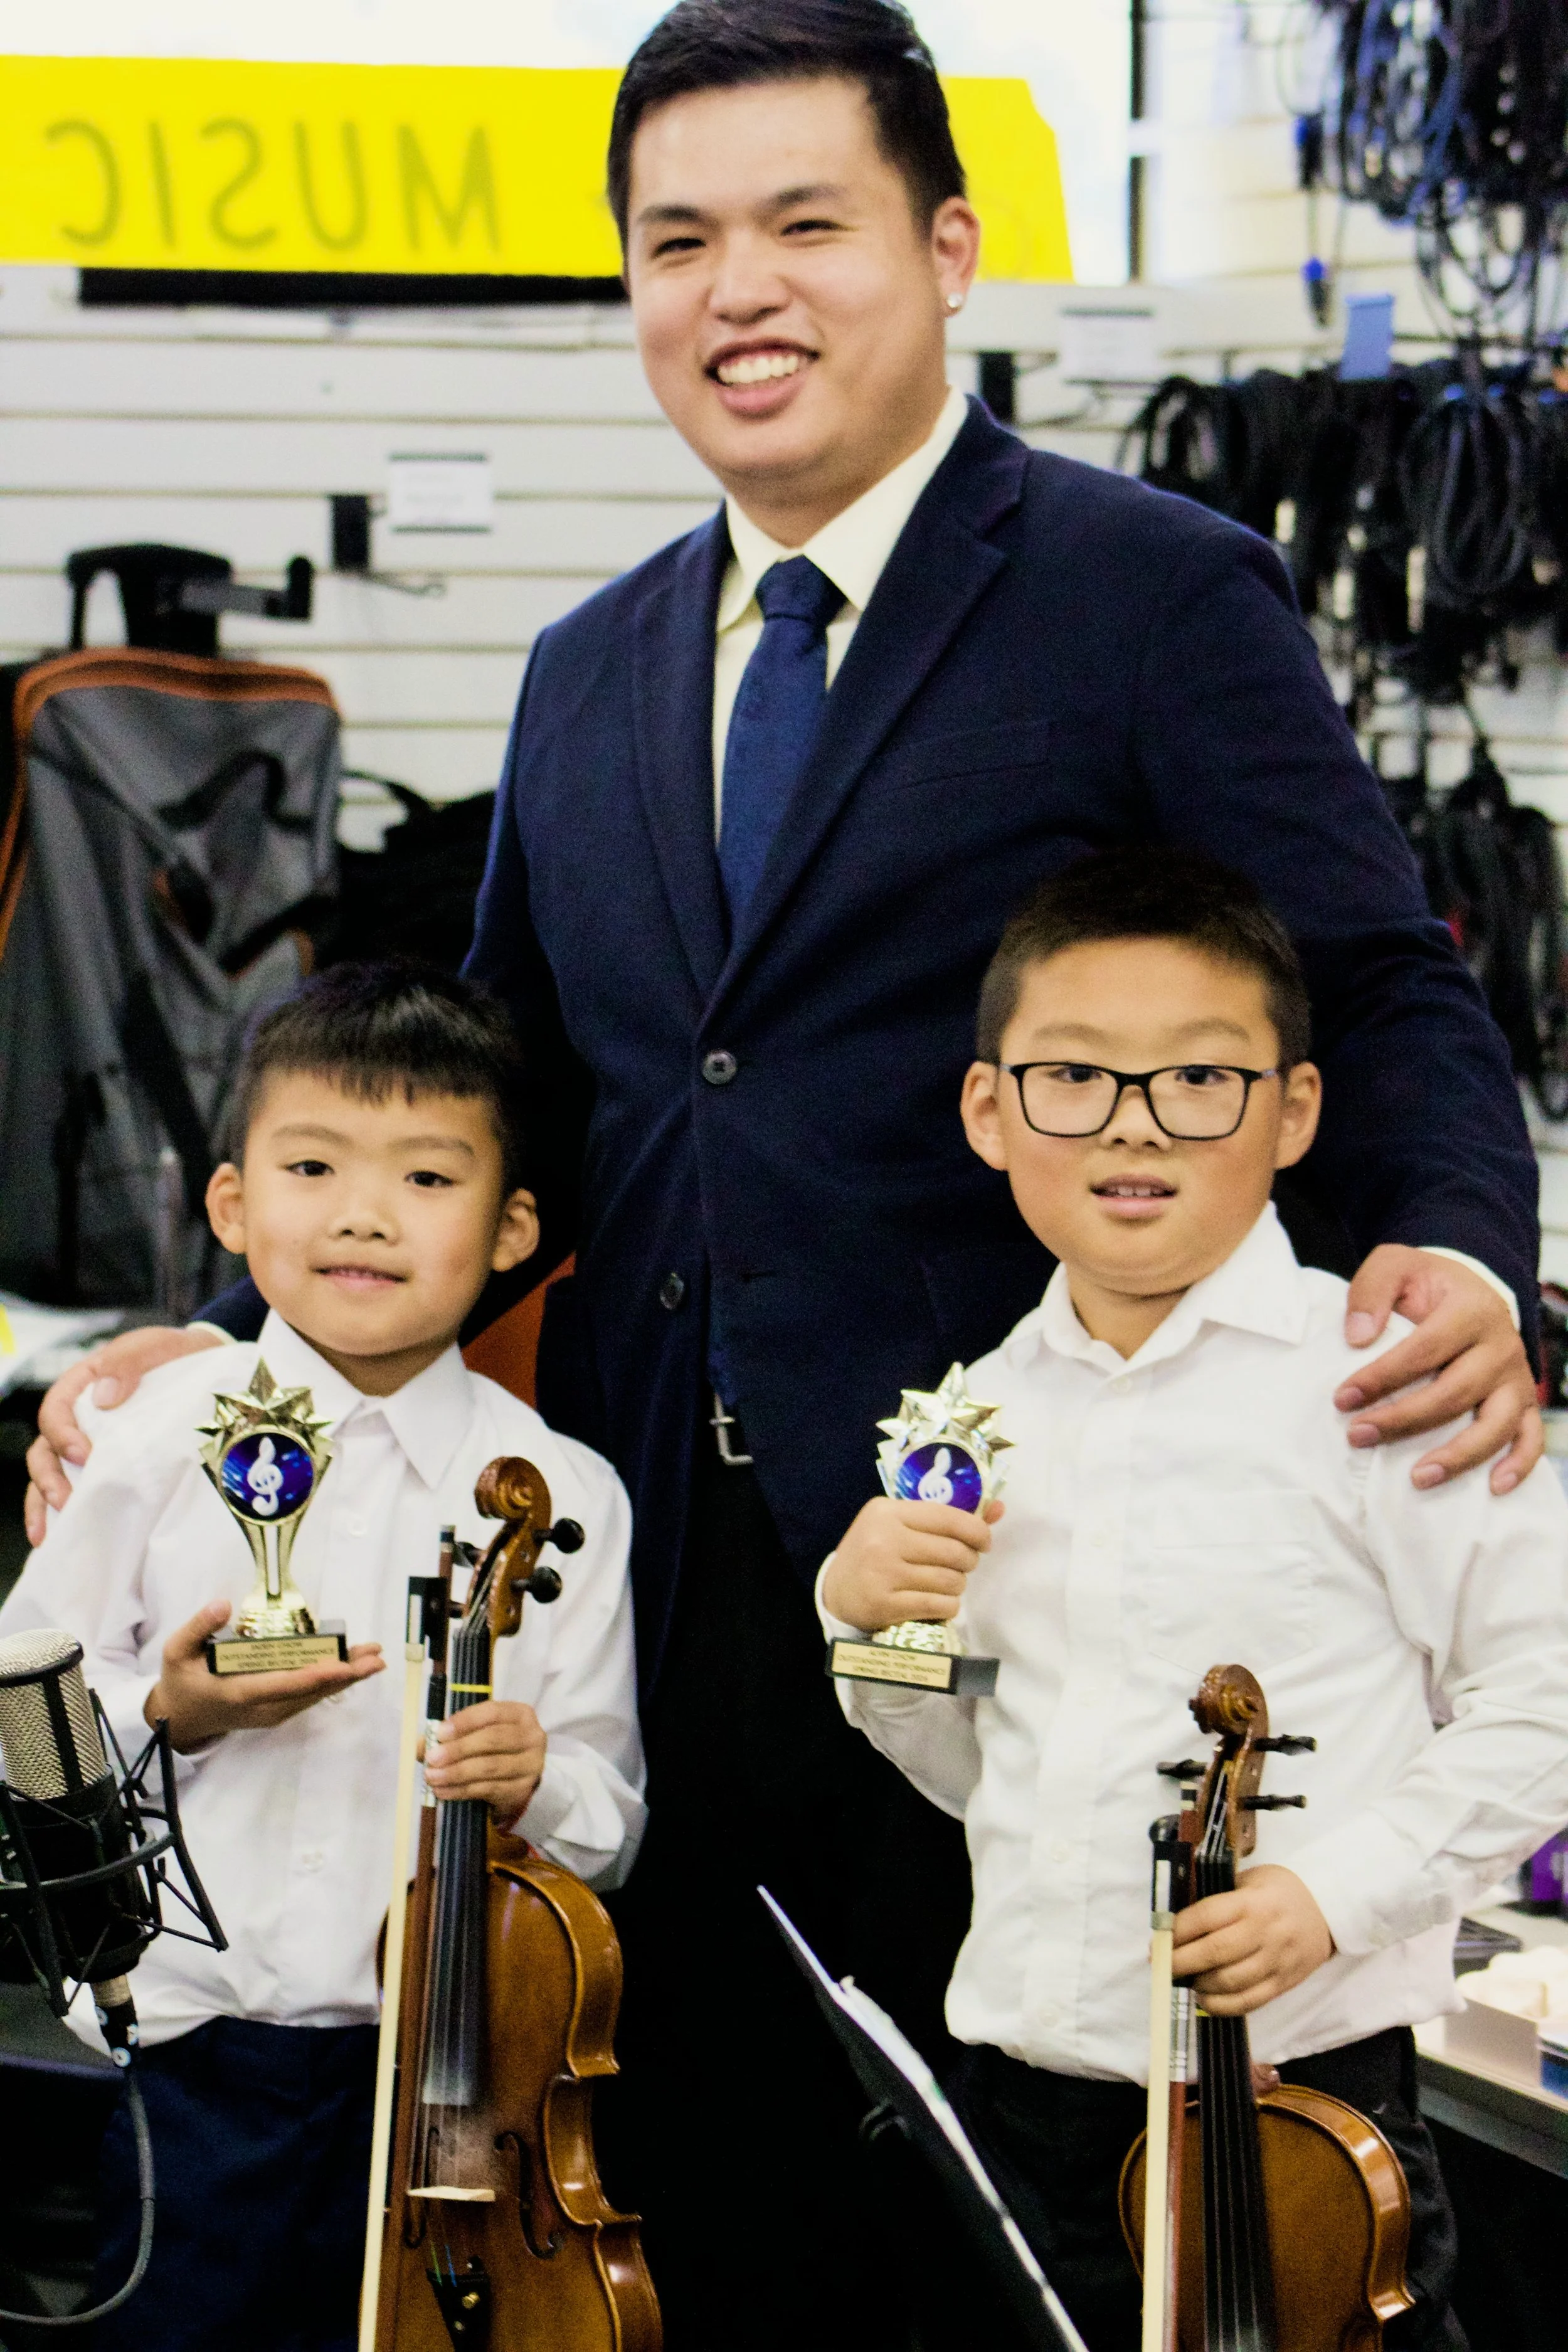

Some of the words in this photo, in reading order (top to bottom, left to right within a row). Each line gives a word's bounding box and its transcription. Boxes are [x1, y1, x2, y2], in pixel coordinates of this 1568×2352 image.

[220, 1651, 276, 1661] OUTSTANDING
[278, 1648, 334, 1658] PERFORMANCE
[837, 1654, 890, 1666] OUTSTANDING
[892, 1662, 946, 1675] PERFORMANCE
